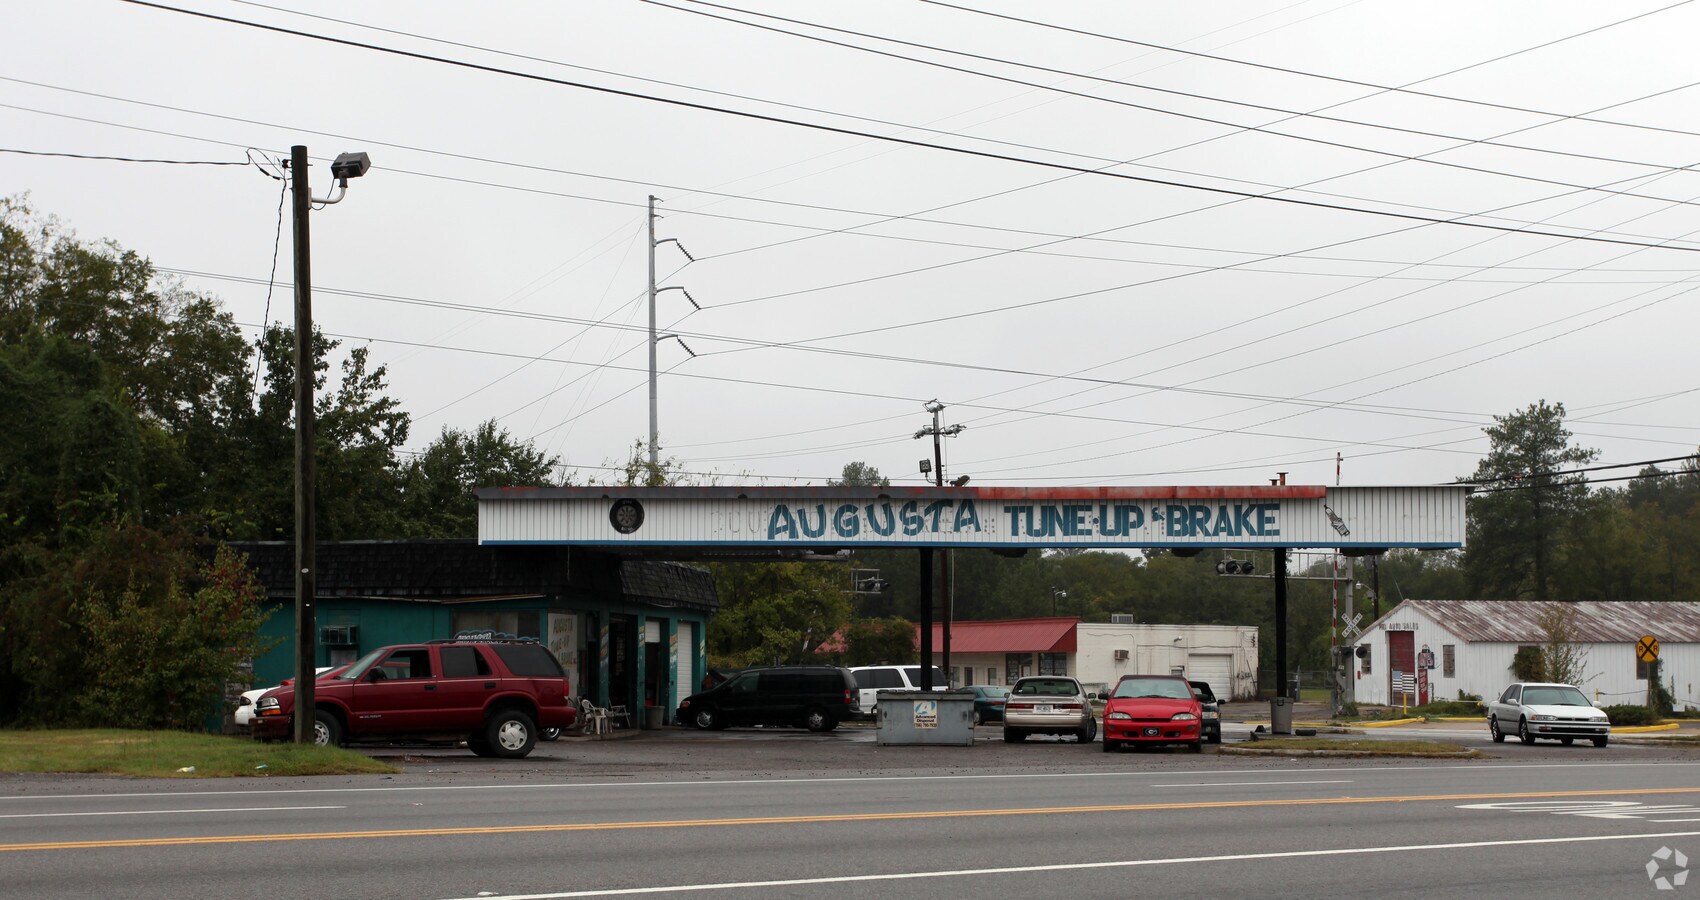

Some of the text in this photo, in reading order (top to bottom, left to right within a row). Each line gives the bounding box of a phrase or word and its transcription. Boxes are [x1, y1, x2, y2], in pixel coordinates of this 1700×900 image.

[767, 499, 982, 540] AUGUSTA
[1152, 507, 1166, 522] &
[1166, 503, 1281, 537] BRAKE
[553, 618, 574, 634] AUGUSTA
[1402, 621, 1419, 631] SALES
